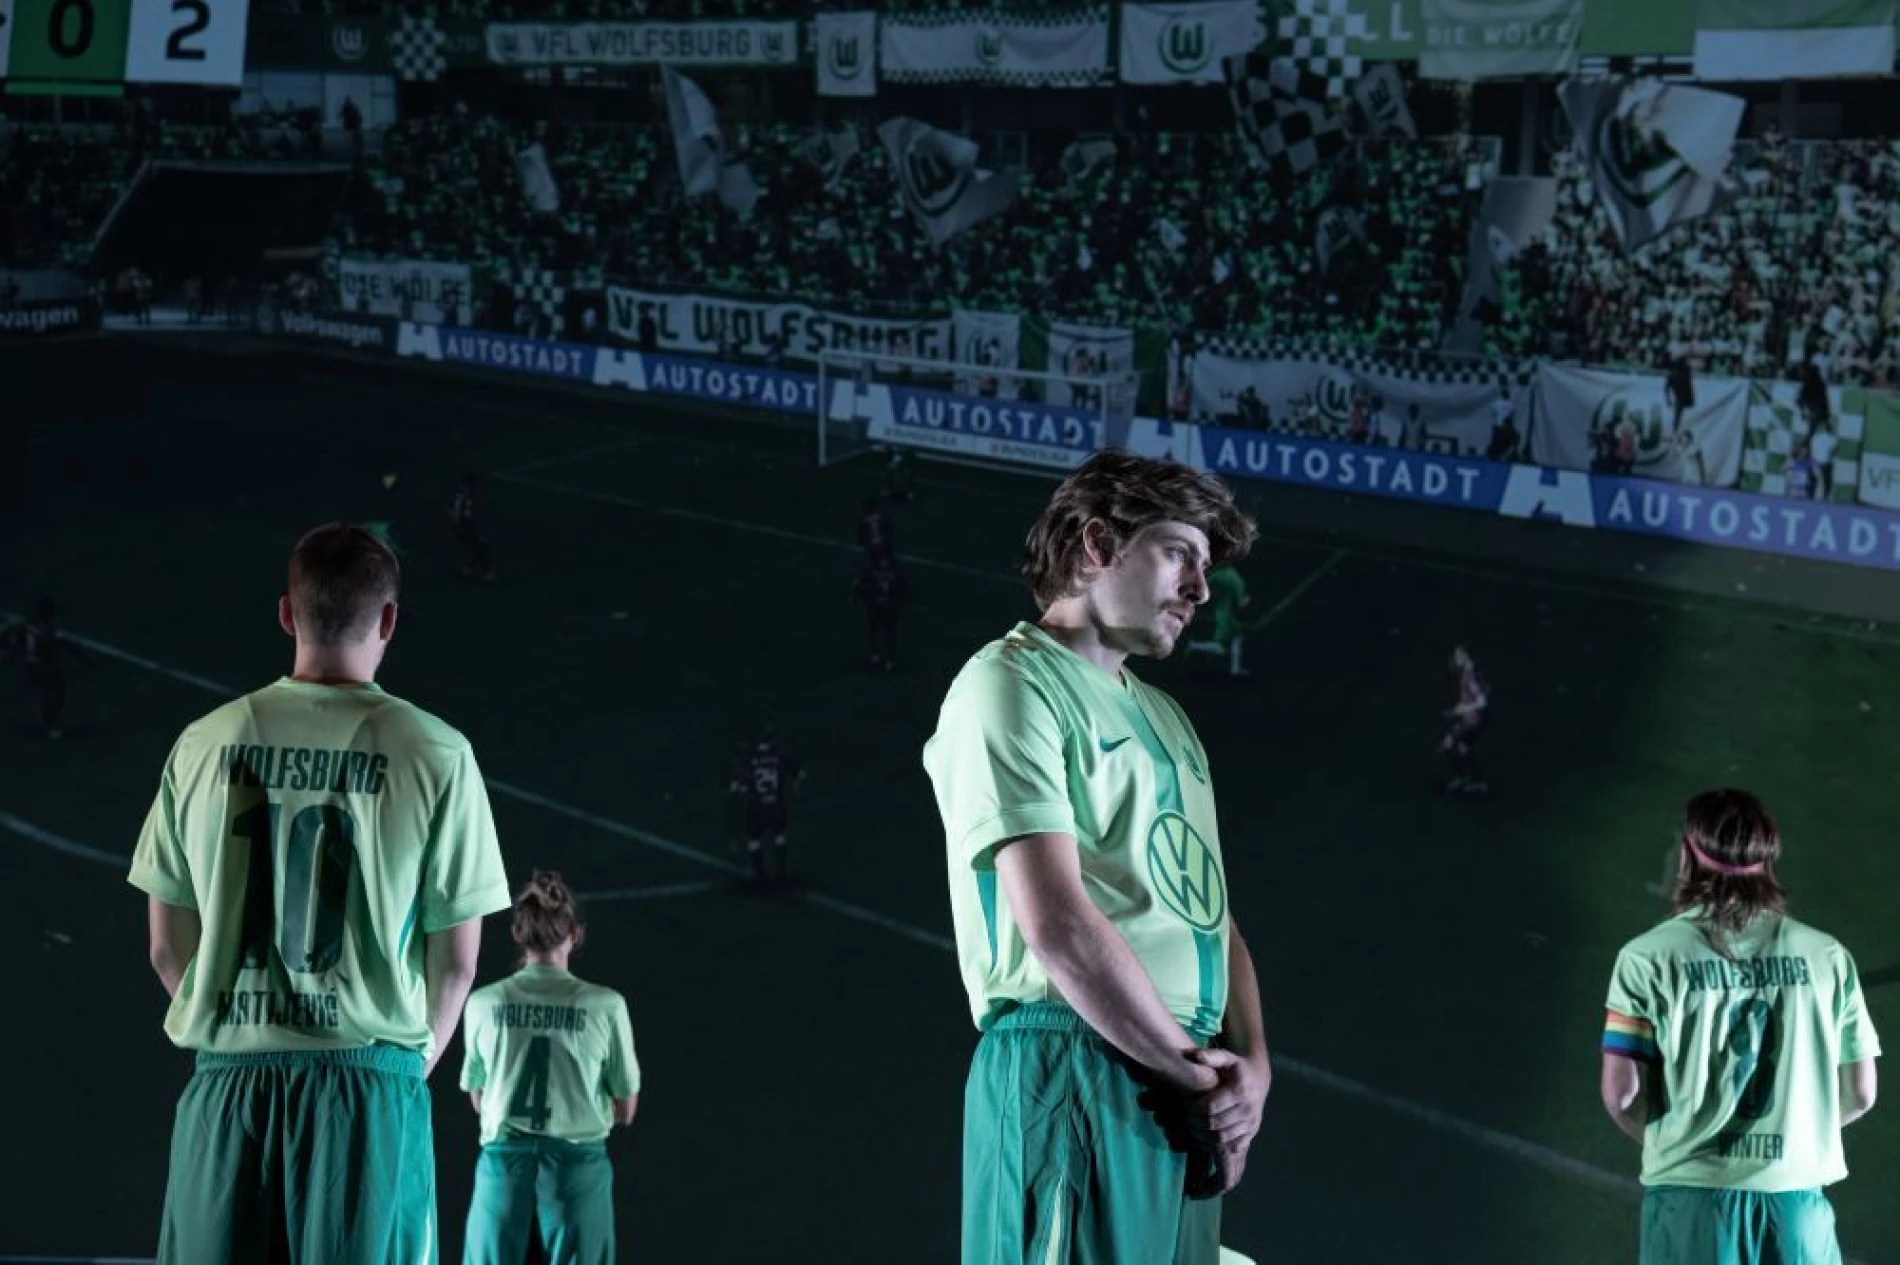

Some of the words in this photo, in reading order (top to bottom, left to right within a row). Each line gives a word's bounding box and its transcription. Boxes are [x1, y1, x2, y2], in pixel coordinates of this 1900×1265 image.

[49, 0, 95, 57] 0
[166, 0, 209, 59] 2
[586, 28, 751, 57] WOLFSBURG
[446, 335, 584, 377] AUTOSTADT
[652, 362, 818, 409] AUTOSTADT
[1217, 437, 1481, 500] AUTOSTADT
[220, 744, 388, 794] WOLFSBURG
[232, 802, 355, 973] 10
[1684, 956, 1810, 991] WOLFSBURG
[492, 1003, 588, 1032] WOLFSBURG
[510, 1036, 552, 1131] 4
[1719, 1132, 1783, 1160] WINTER
